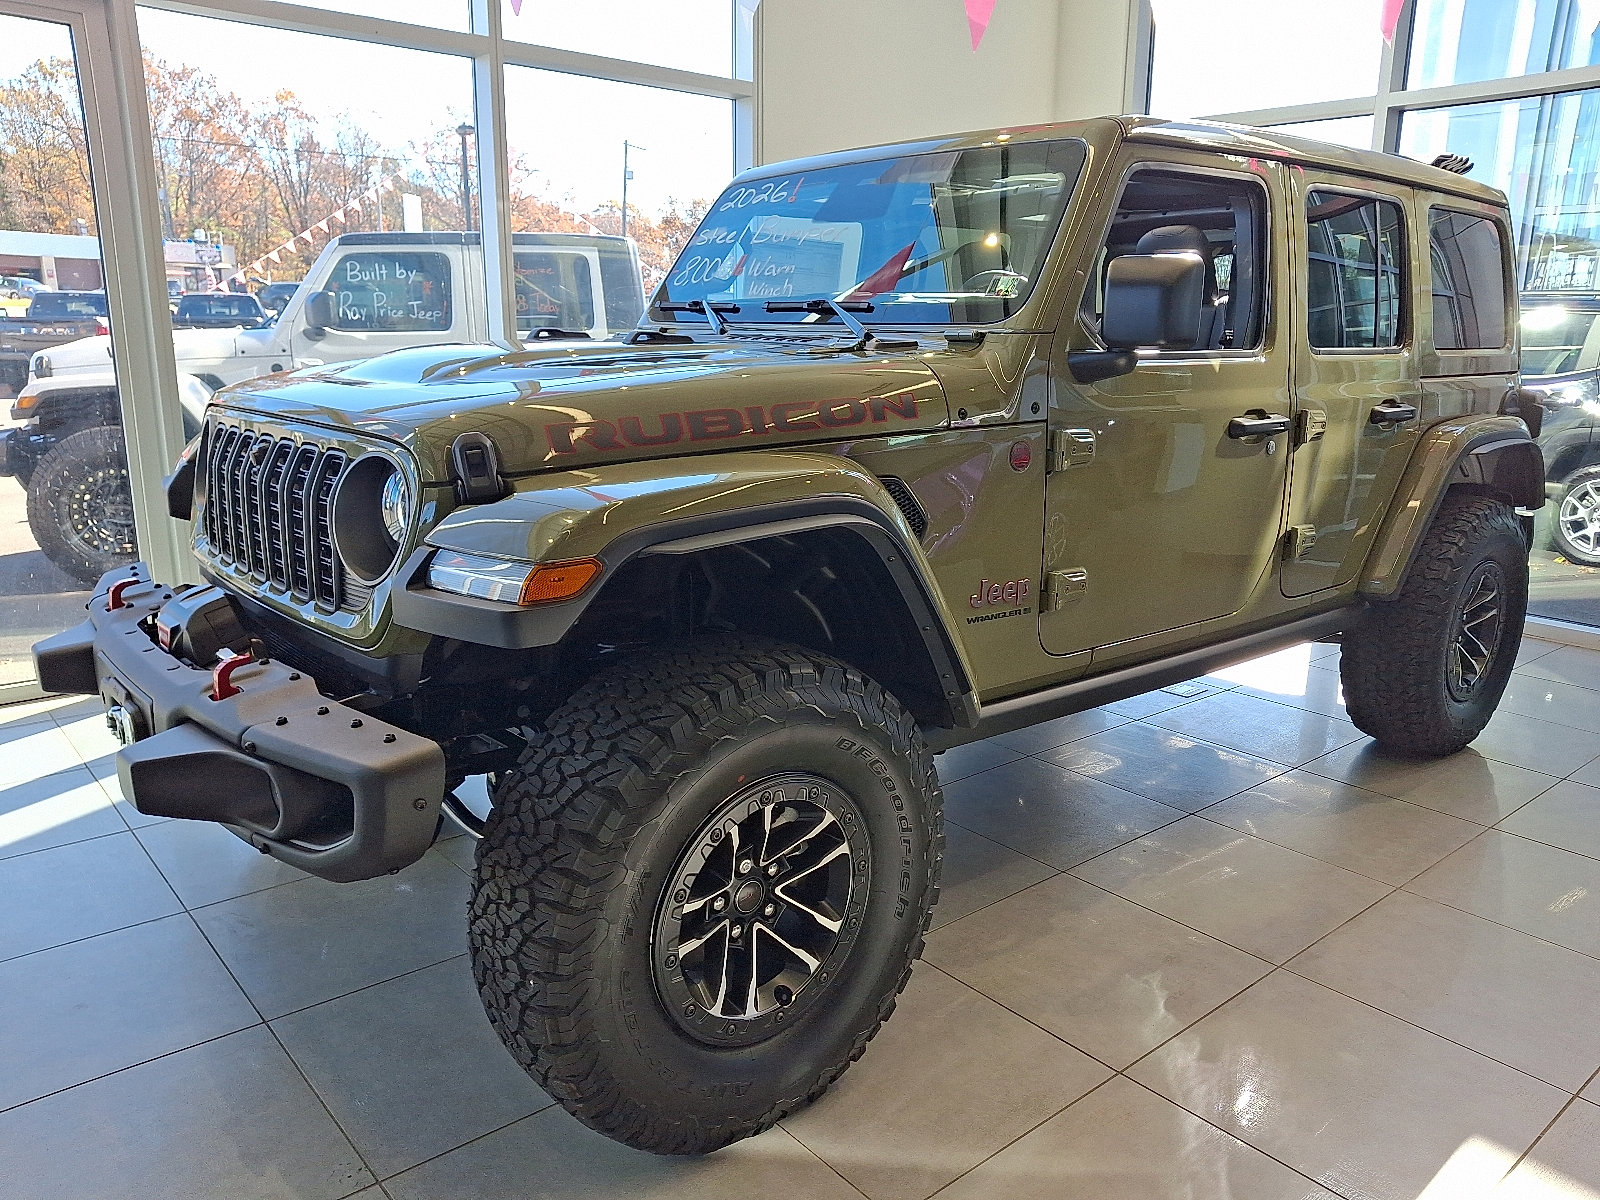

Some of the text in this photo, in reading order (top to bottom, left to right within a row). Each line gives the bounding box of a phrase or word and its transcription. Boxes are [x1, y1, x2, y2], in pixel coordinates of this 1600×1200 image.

[346, 261, 417, 284] Built by
[339, 291, 367, 321] Ray
[373, 288, 405, 318] Price
[544, 393, 920, 456] RUBICON
[969, 577, 1030, 608] Jeep
[966, 608, 1022, 625] WRANGLER
[833, 735, 913, 921] BFGoodrich
